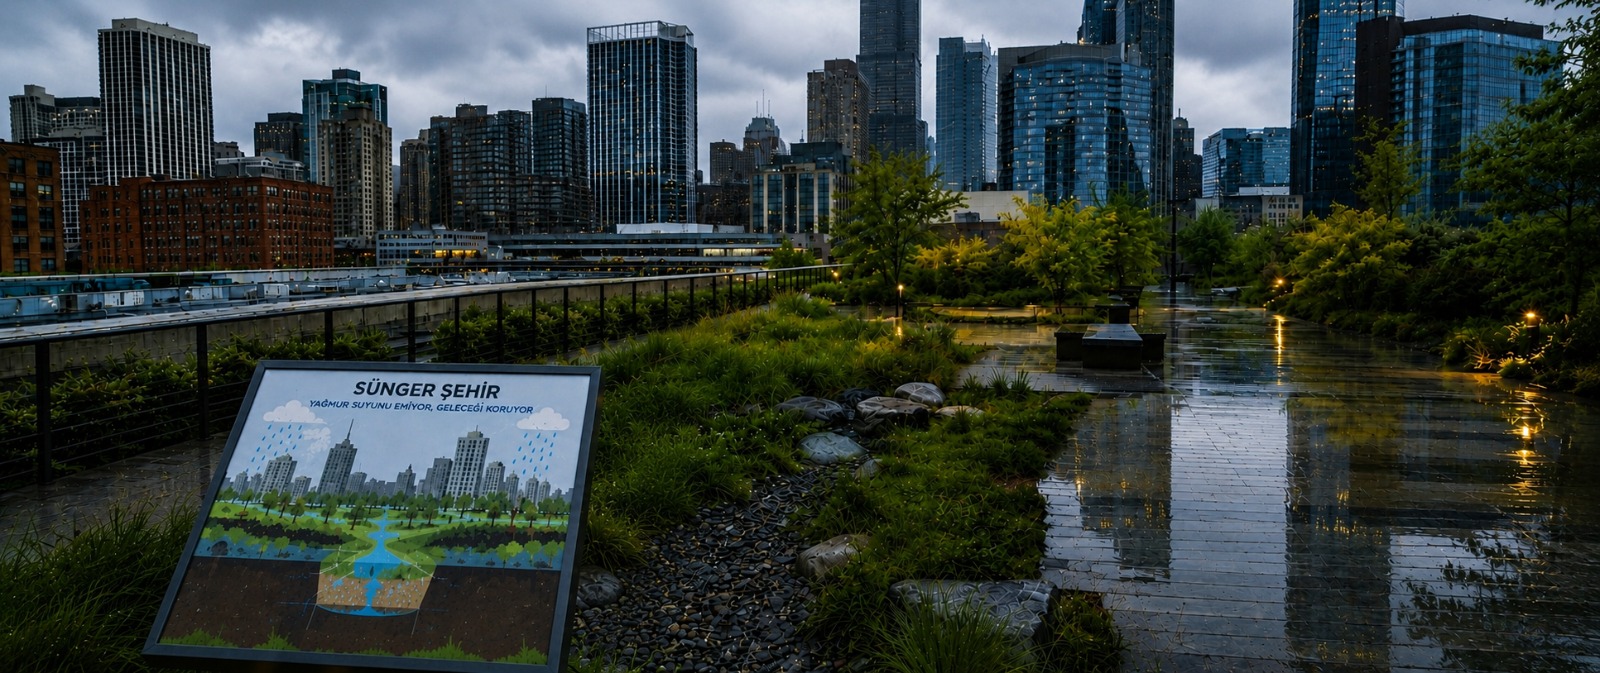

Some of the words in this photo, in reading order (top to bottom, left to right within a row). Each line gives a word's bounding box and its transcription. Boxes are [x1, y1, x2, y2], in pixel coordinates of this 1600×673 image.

[353, 378, 436, 397] SÜNGER
[440, 381, 500, 401] ŞEHİR
[309, 399, 349, 409] YAĞMUR
[351, 401, 392, 410] SUYUNU
[394, 401, 434, 412] EMİYOR,
[436, 402, 484, 413] GELECEĞİ
[486, 404, 534, 414] KORUYOR
